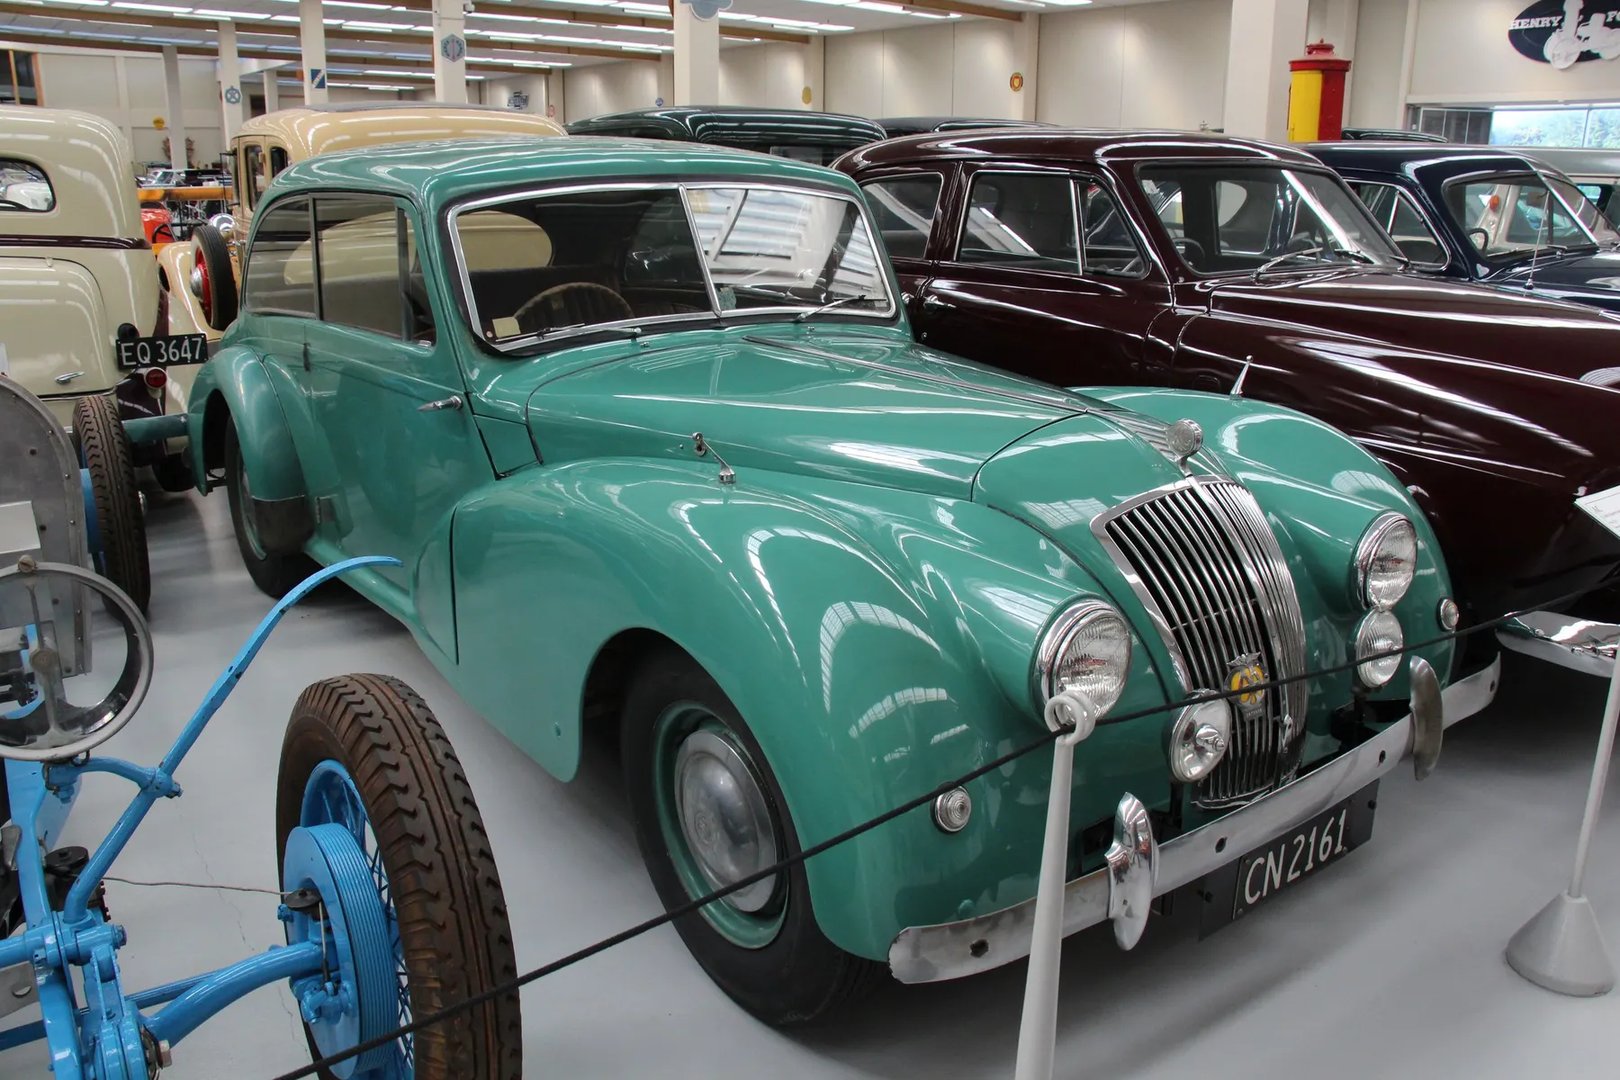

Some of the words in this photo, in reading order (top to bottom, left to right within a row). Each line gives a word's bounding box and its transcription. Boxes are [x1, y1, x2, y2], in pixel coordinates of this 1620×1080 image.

[1508, 15, 1563, 30] HENRY
[120, 341, 152, 366] EQ
[155, 337, 203, 363] 3647
